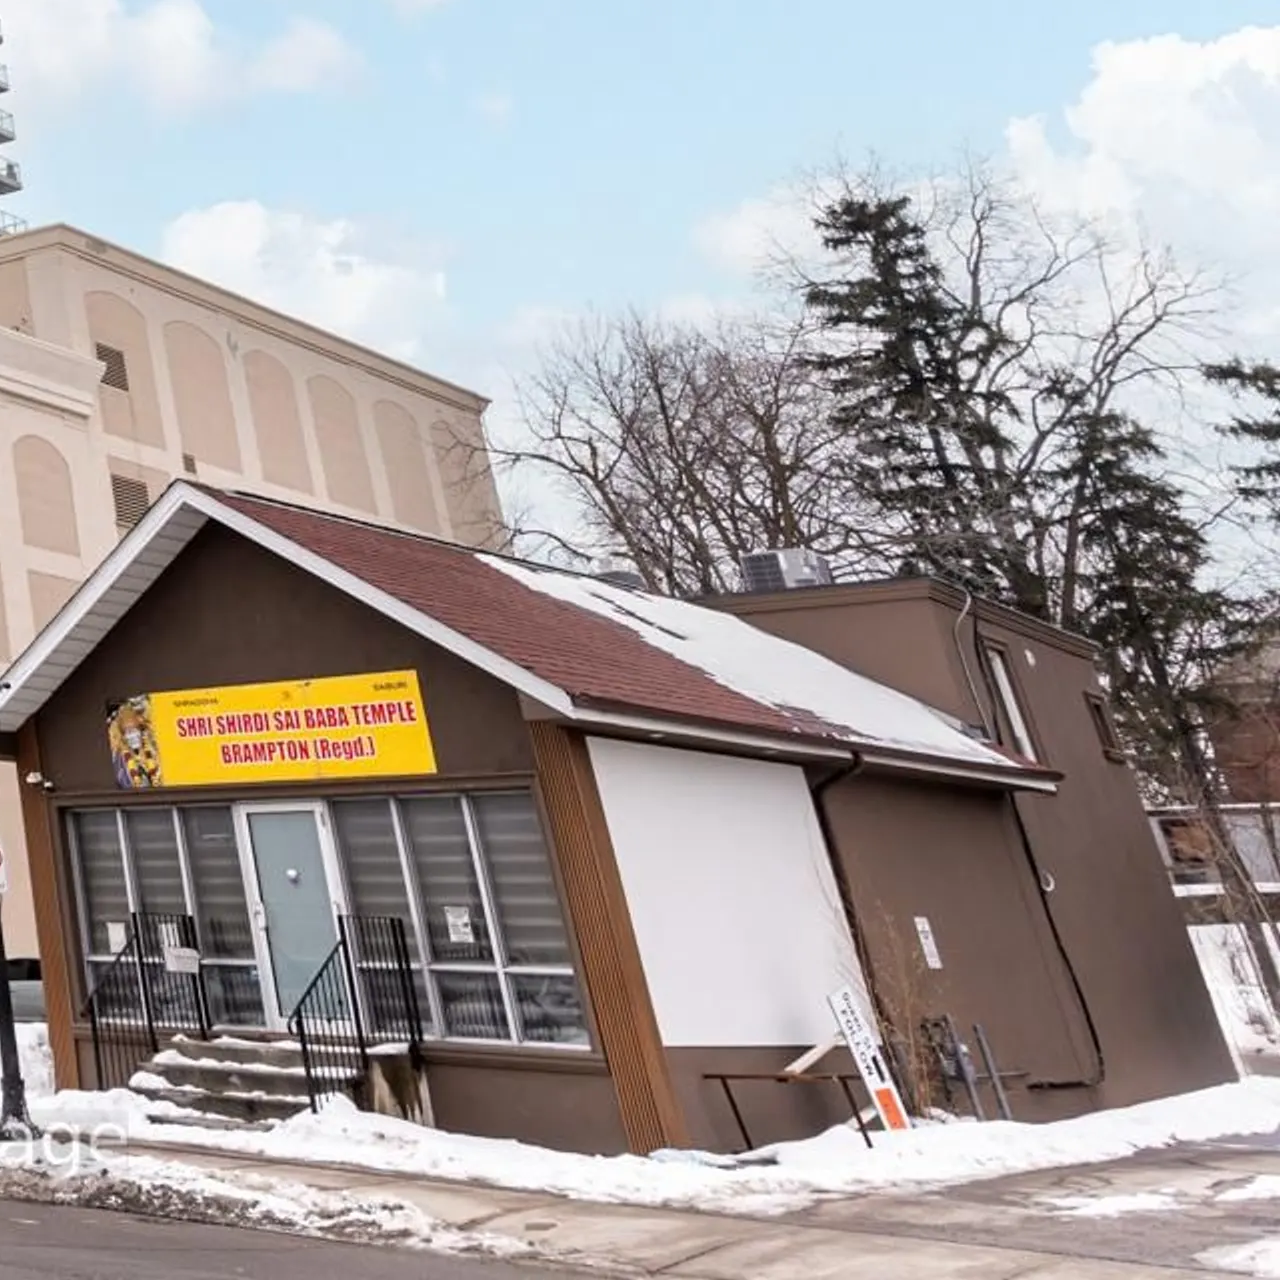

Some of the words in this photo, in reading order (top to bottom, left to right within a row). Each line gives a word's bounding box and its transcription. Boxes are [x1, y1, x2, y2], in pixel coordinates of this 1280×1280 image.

[176, 715, 212, 738] SHRI
[216, 711, 269, 734] SHIRDI
[274, 709, 301, 732] SAI
[304, 705, 349, 729] BABA
[351, 700, 417, 725] TEMPLE
[221, 739, 310, 764] BRAMPTON
